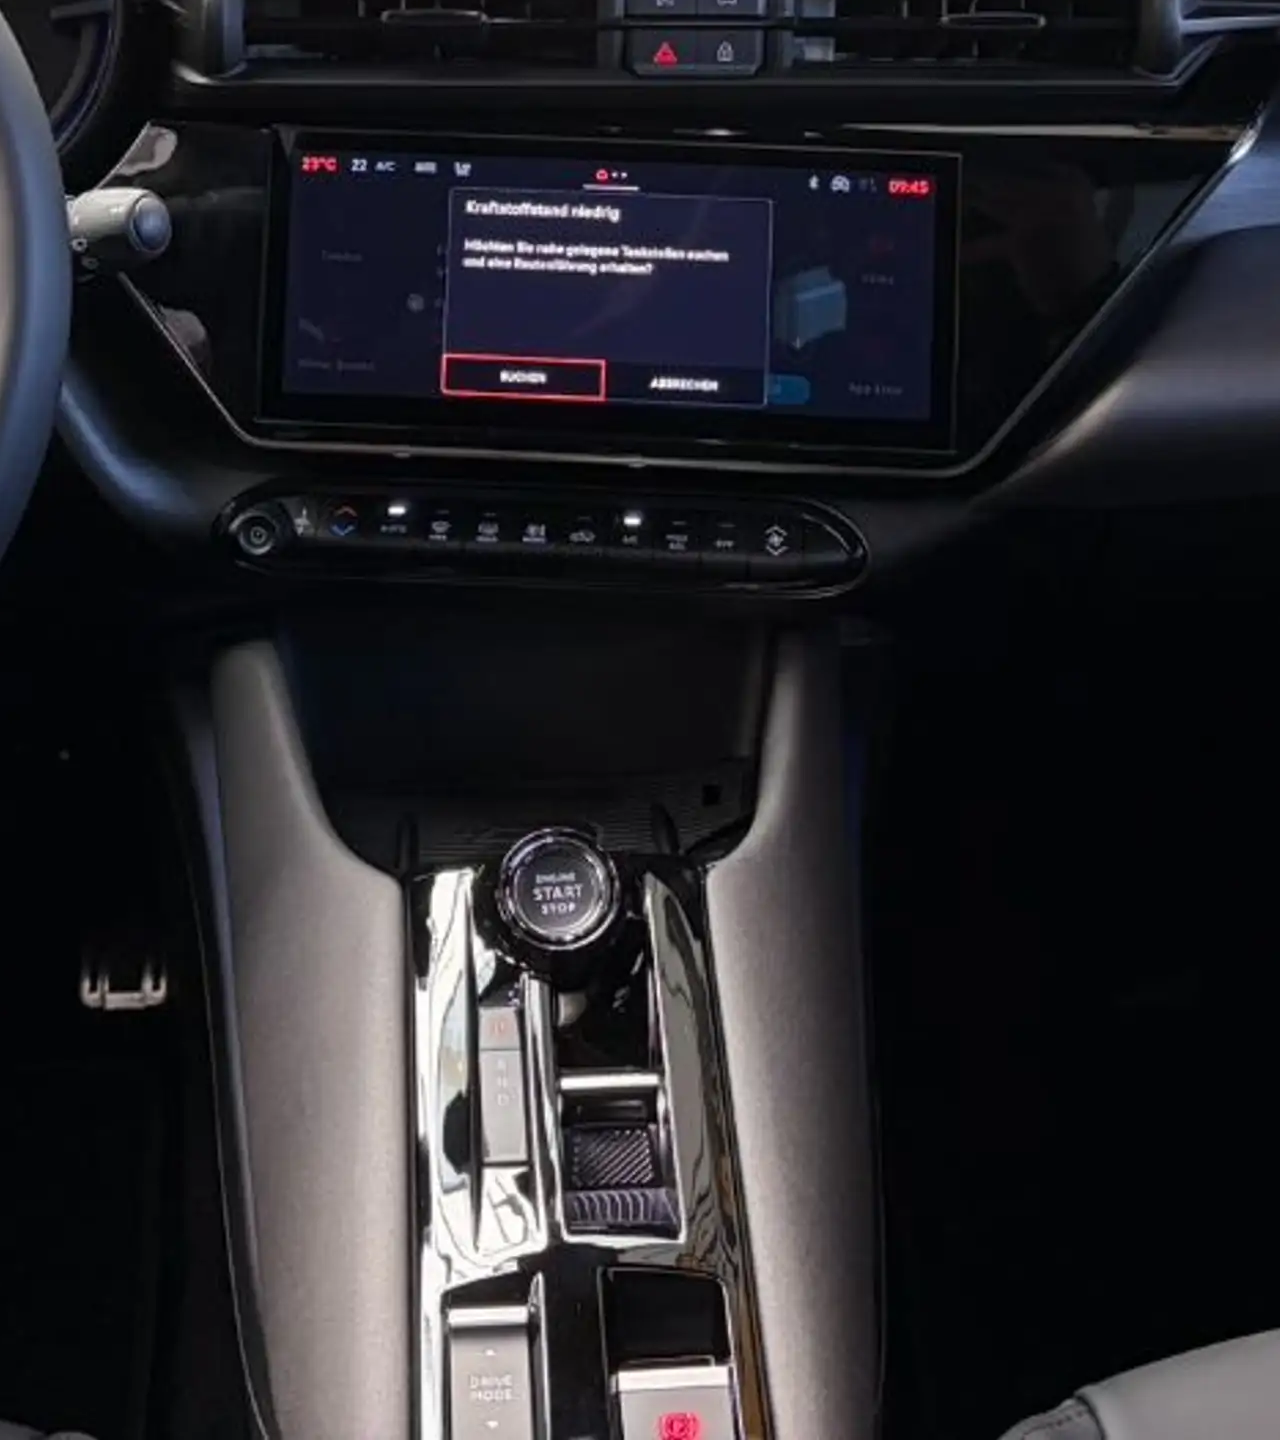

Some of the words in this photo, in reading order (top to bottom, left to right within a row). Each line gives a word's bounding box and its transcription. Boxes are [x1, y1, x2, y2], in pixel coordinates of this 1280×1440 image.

[351, 158, 368, 172] 22
[888, 179, 930, 195] 09:45
[466, 200, 569, 218] Kraftstoffstand
[572, 205, 620, 223] niedrig
[517, 240, 534, 254] Sie
[566, 244, 619, 259] gelegene
[463, 256, 485, 268] und
[487, 257, 512, 269] eine
[532, 883, 583, 901] START
[541, 901, 576, 915] STOP
[470, 1374, 513, 1390] DRIVE
[470, 1389, 513, 1403] MODE
